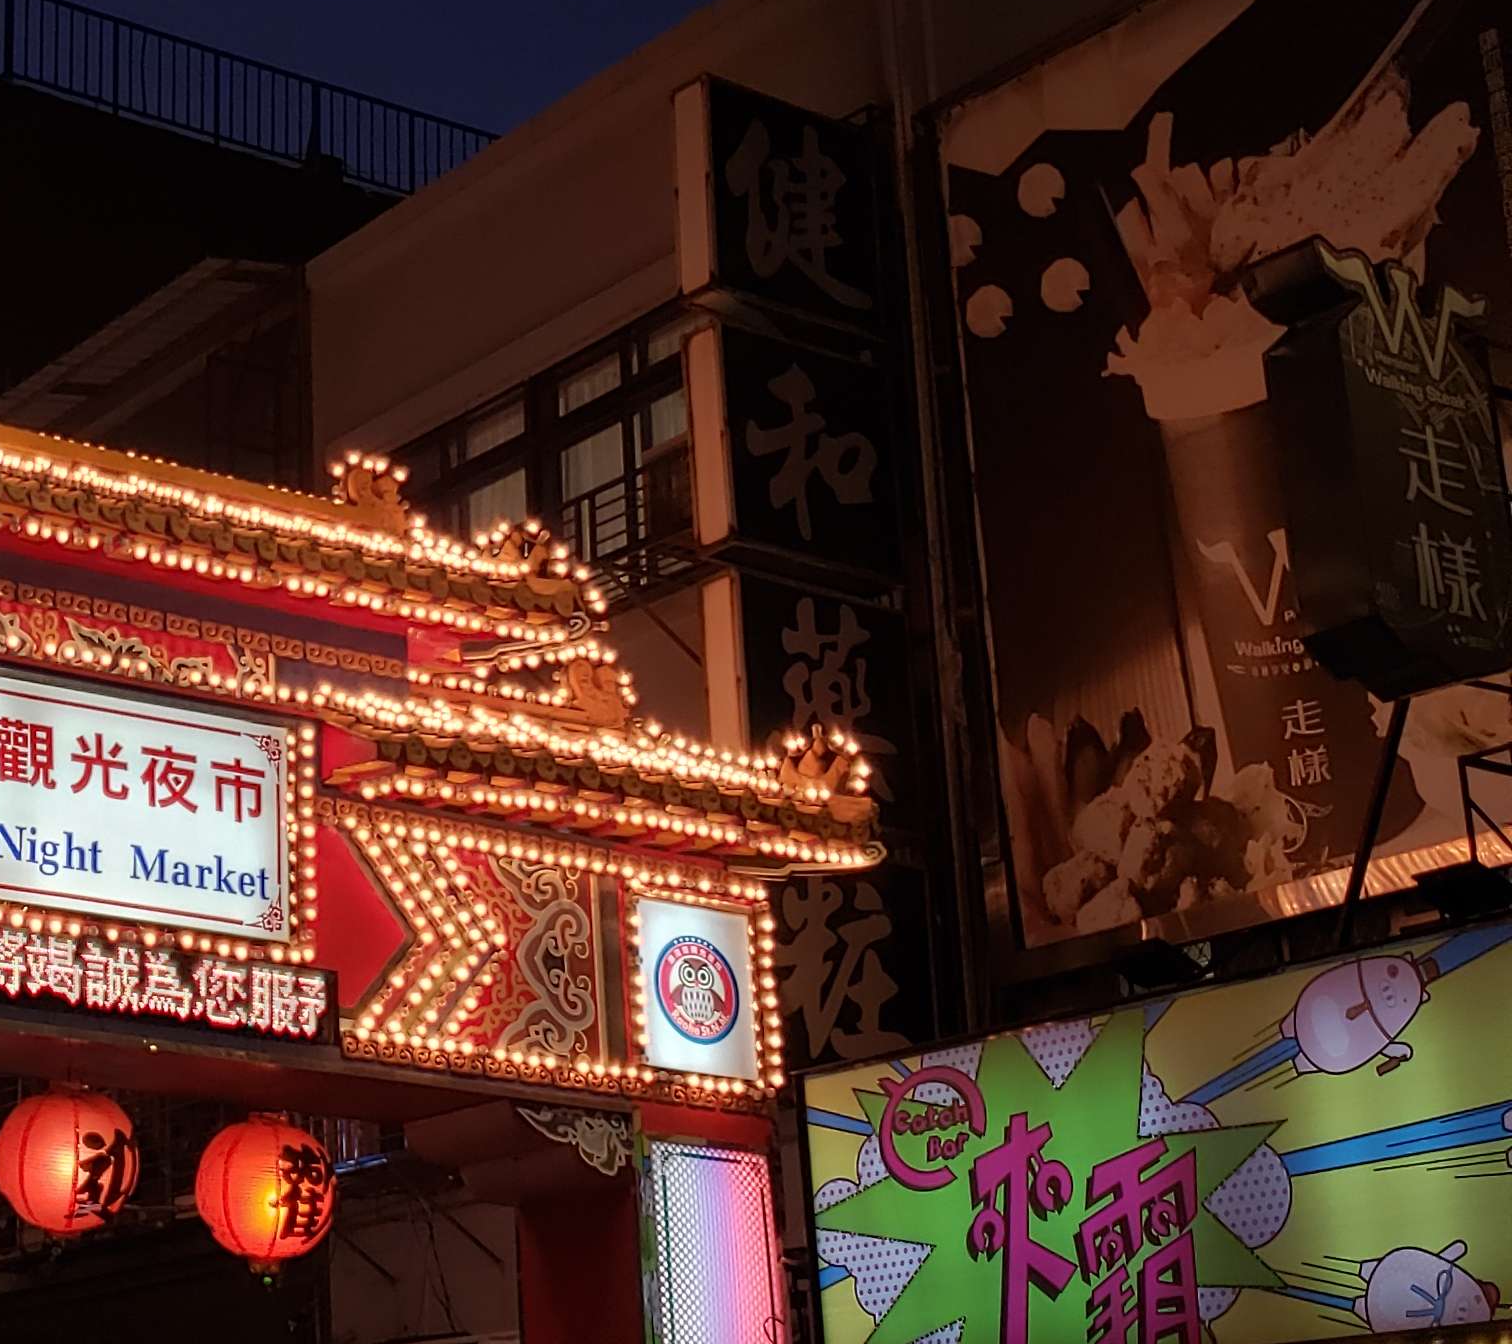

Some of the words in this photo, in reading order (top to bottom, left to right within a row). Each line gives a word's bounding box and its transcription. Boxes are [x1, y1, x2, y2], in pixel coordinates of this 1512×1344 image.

[1399, 423, 1487, 622] 走樣
[1281, 698, 1333, 787] 走樣
[130, 843, 272, 902] Market
[927, 1131, 970, 1163] Bar
